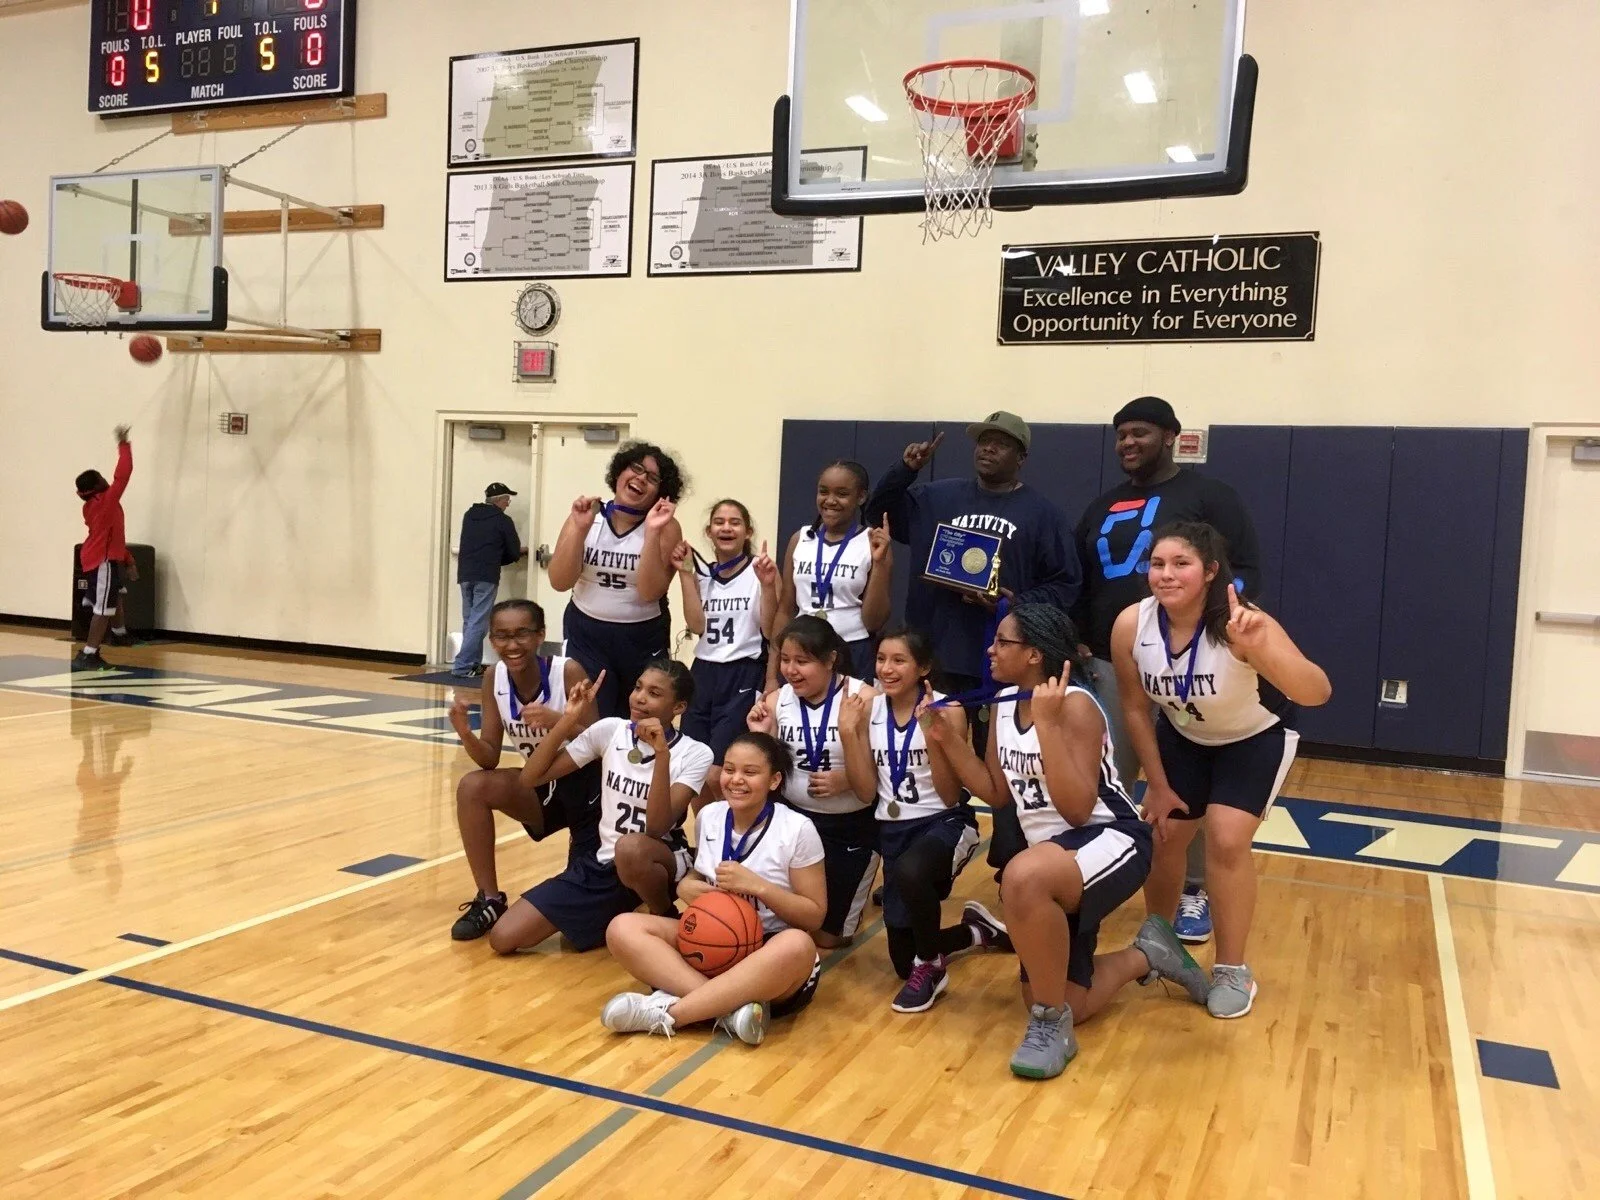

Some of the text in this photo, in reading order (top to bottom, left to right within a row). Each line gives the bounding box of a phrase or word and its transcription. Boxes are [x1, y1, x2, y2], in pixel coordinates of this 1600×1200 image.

[254, 21, 282, 36] T.O.L.
[294, 14, 327, 32] FOULS
[101, 39, 130, 54] FOULS
[141, 36, 166, 50] T.O.L.
[176, 24, 243, 46] PLAYER FOUL
[259, 37, 275, 71] 5
[306, 33, 323, 66] 0
[111, 56, 125, 86] 0
[145, 51, 160, 83] 5
[191, 83, 224, 99] MATCH
[293, 73, 327, 90] SCORE
[99, 93, 128, 108] SCORE
[680, 172, 697, 180] 2014
[728, 167, 763, 177] Basketball
[1035, 245, 1281, 277] VALLEY CATHOLIC
[1023, 281, 1289, 307] Excellence in Everything
[1013, 310, 1298, 337] Opportunity for Everyone
[584, 547, 641, 571] NATIVIT
[596, 572, 627, 590] 35
[700, 597, 751, 612] ATIVITY
[706, 617, 735, 645] 54
[606, 770, 650, 800] NATIVI
[615, 802, 647, 834] 25
